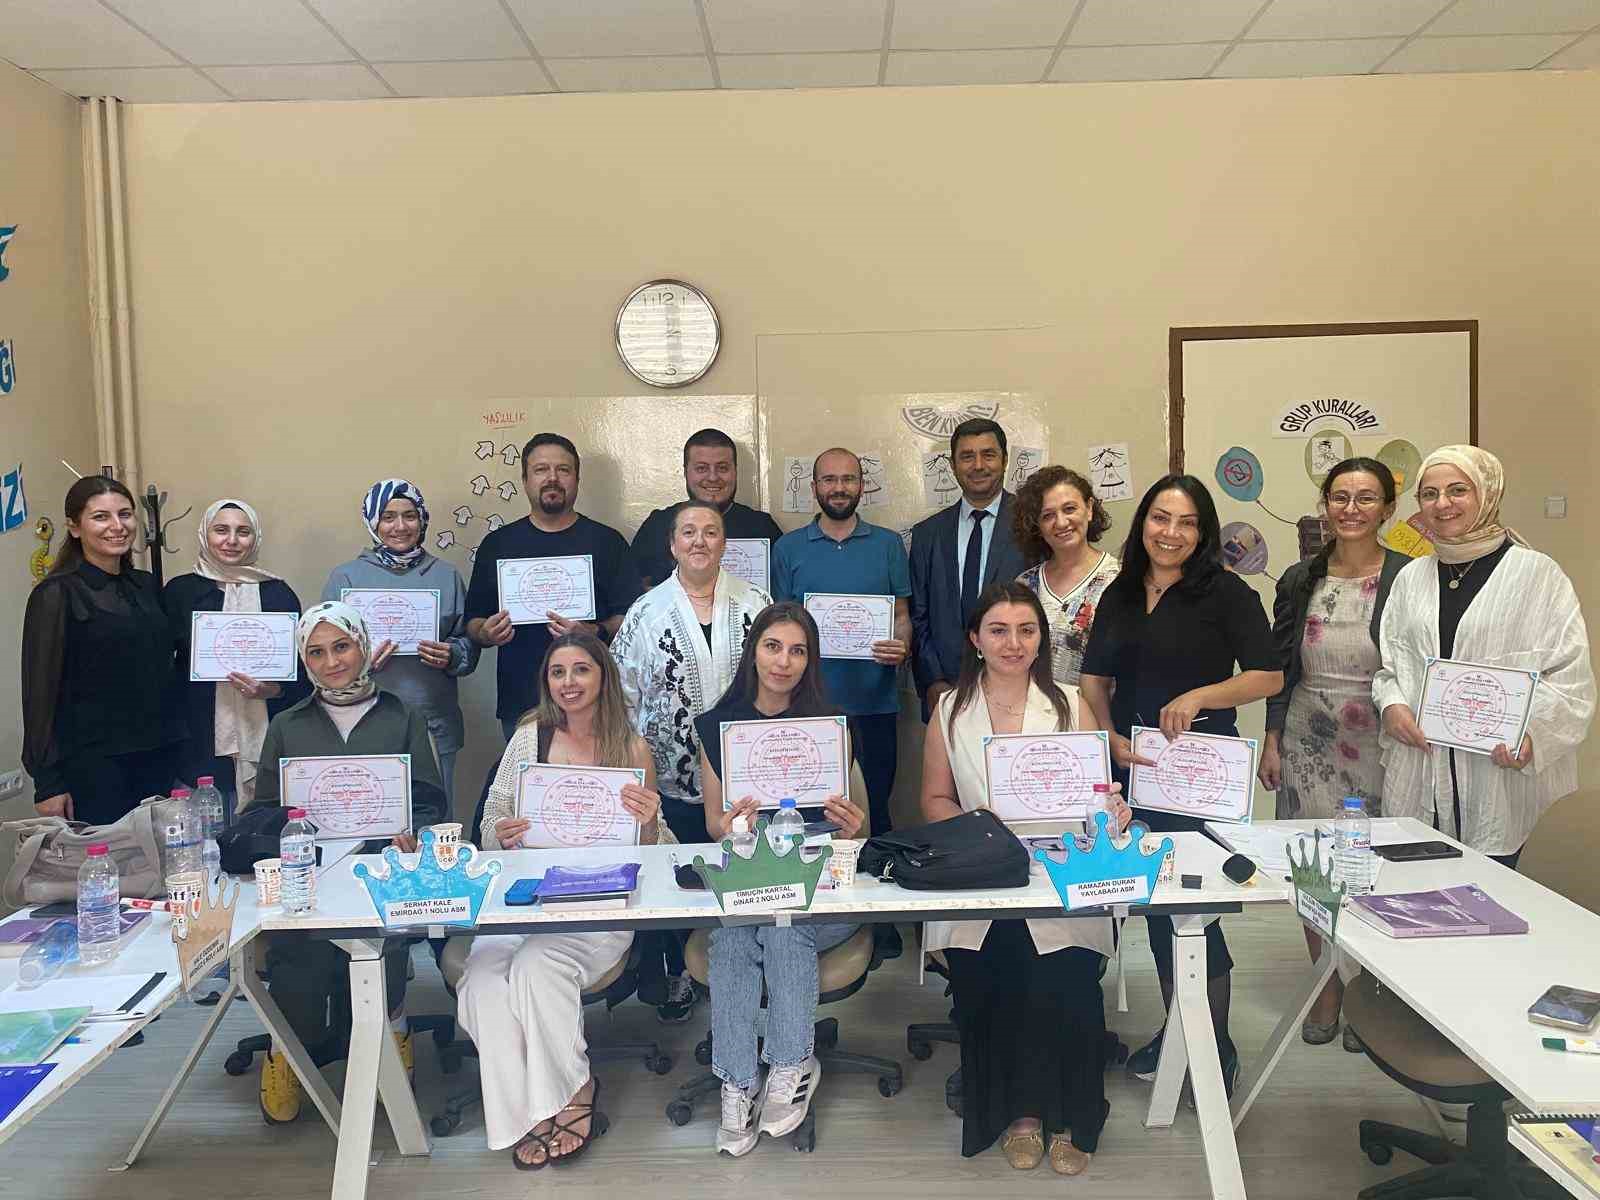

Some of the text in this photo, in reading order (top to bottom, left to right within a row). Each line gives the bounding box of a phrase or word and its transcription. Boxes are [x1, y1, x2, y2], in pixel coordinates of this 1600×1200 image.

[658, 292, 674, 305] 12
[908, 407, 941, 432] BEN
[1280, 399, 1379, 432] GRUP KURALLARI
[765, 886, 793, 894] KARTAL
[1079, 882, 1111, 890] RAMAZAN
[781, 891, 796, 899] ASM
[403, 900, 431, 908] SERHAT
[429, 906, 449, 914] NOLU
